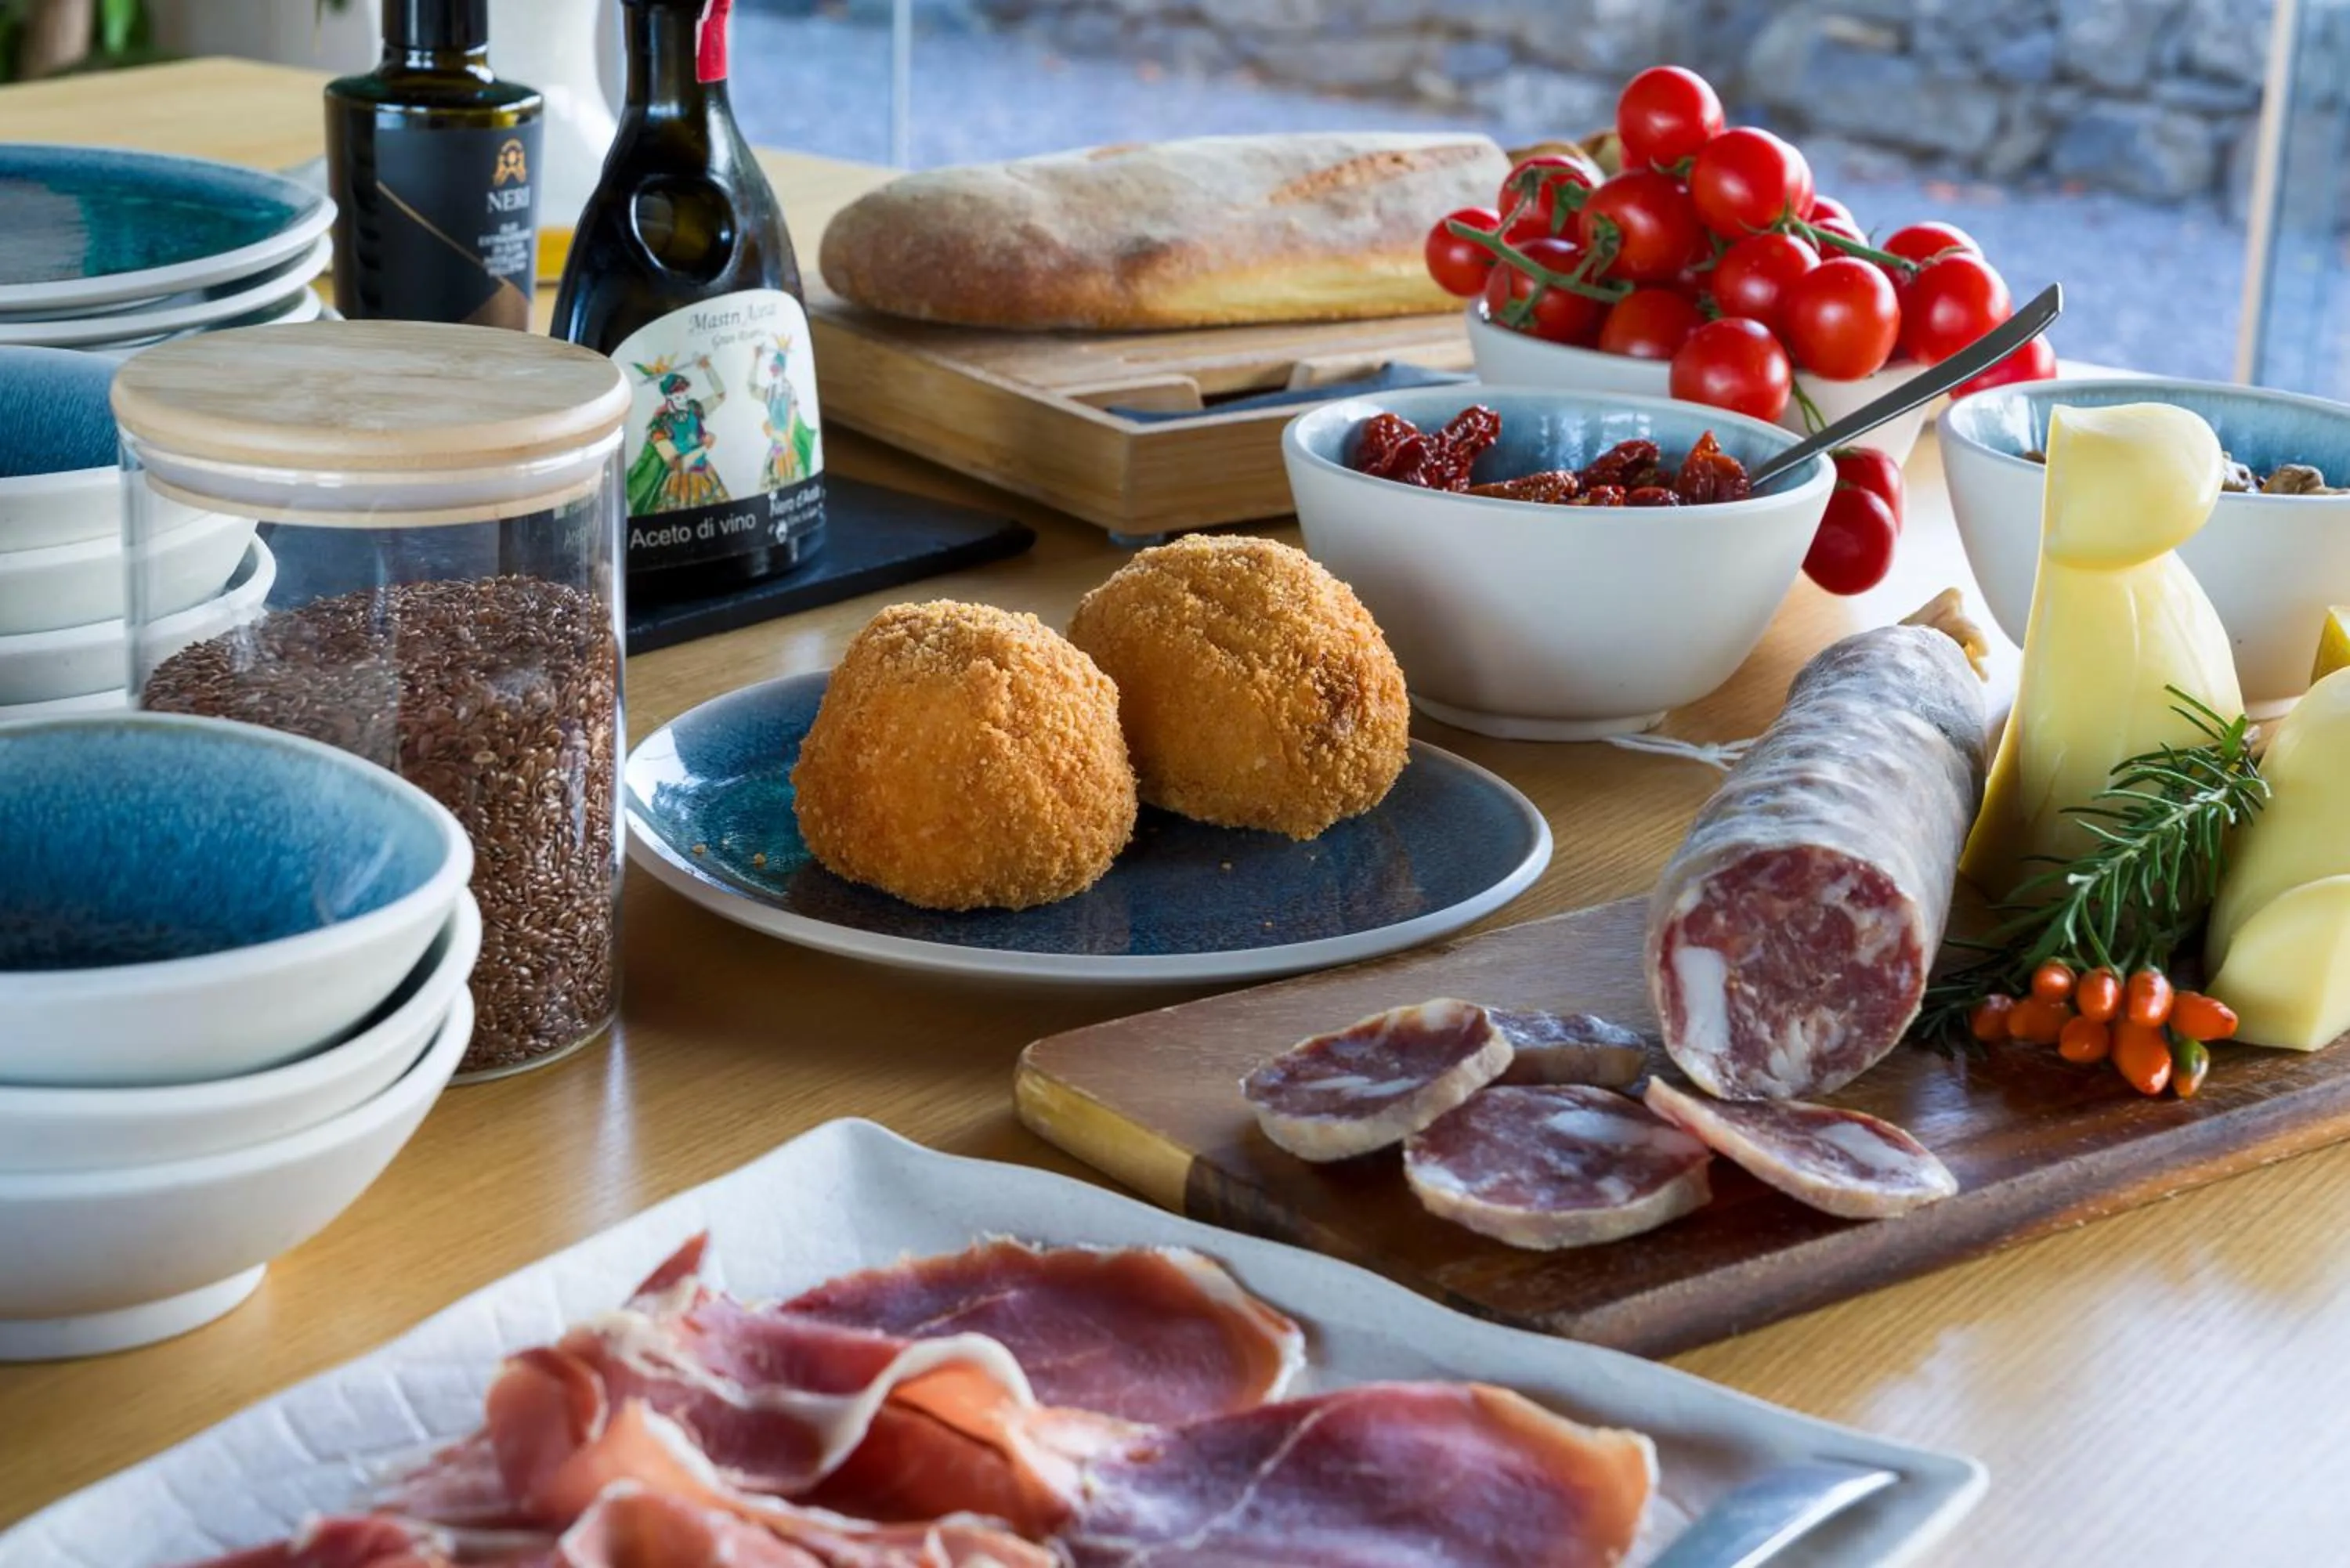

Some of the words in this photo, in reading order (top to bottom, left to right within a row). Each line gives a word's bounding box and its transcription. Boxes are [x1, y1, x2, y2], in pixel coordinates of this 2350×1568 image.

[486, 186, 530, 213] NERI
[629, 524, 692, 550] Aceto
[696, 517, 716, 540] di
[719, 512, 757, 535] vino
